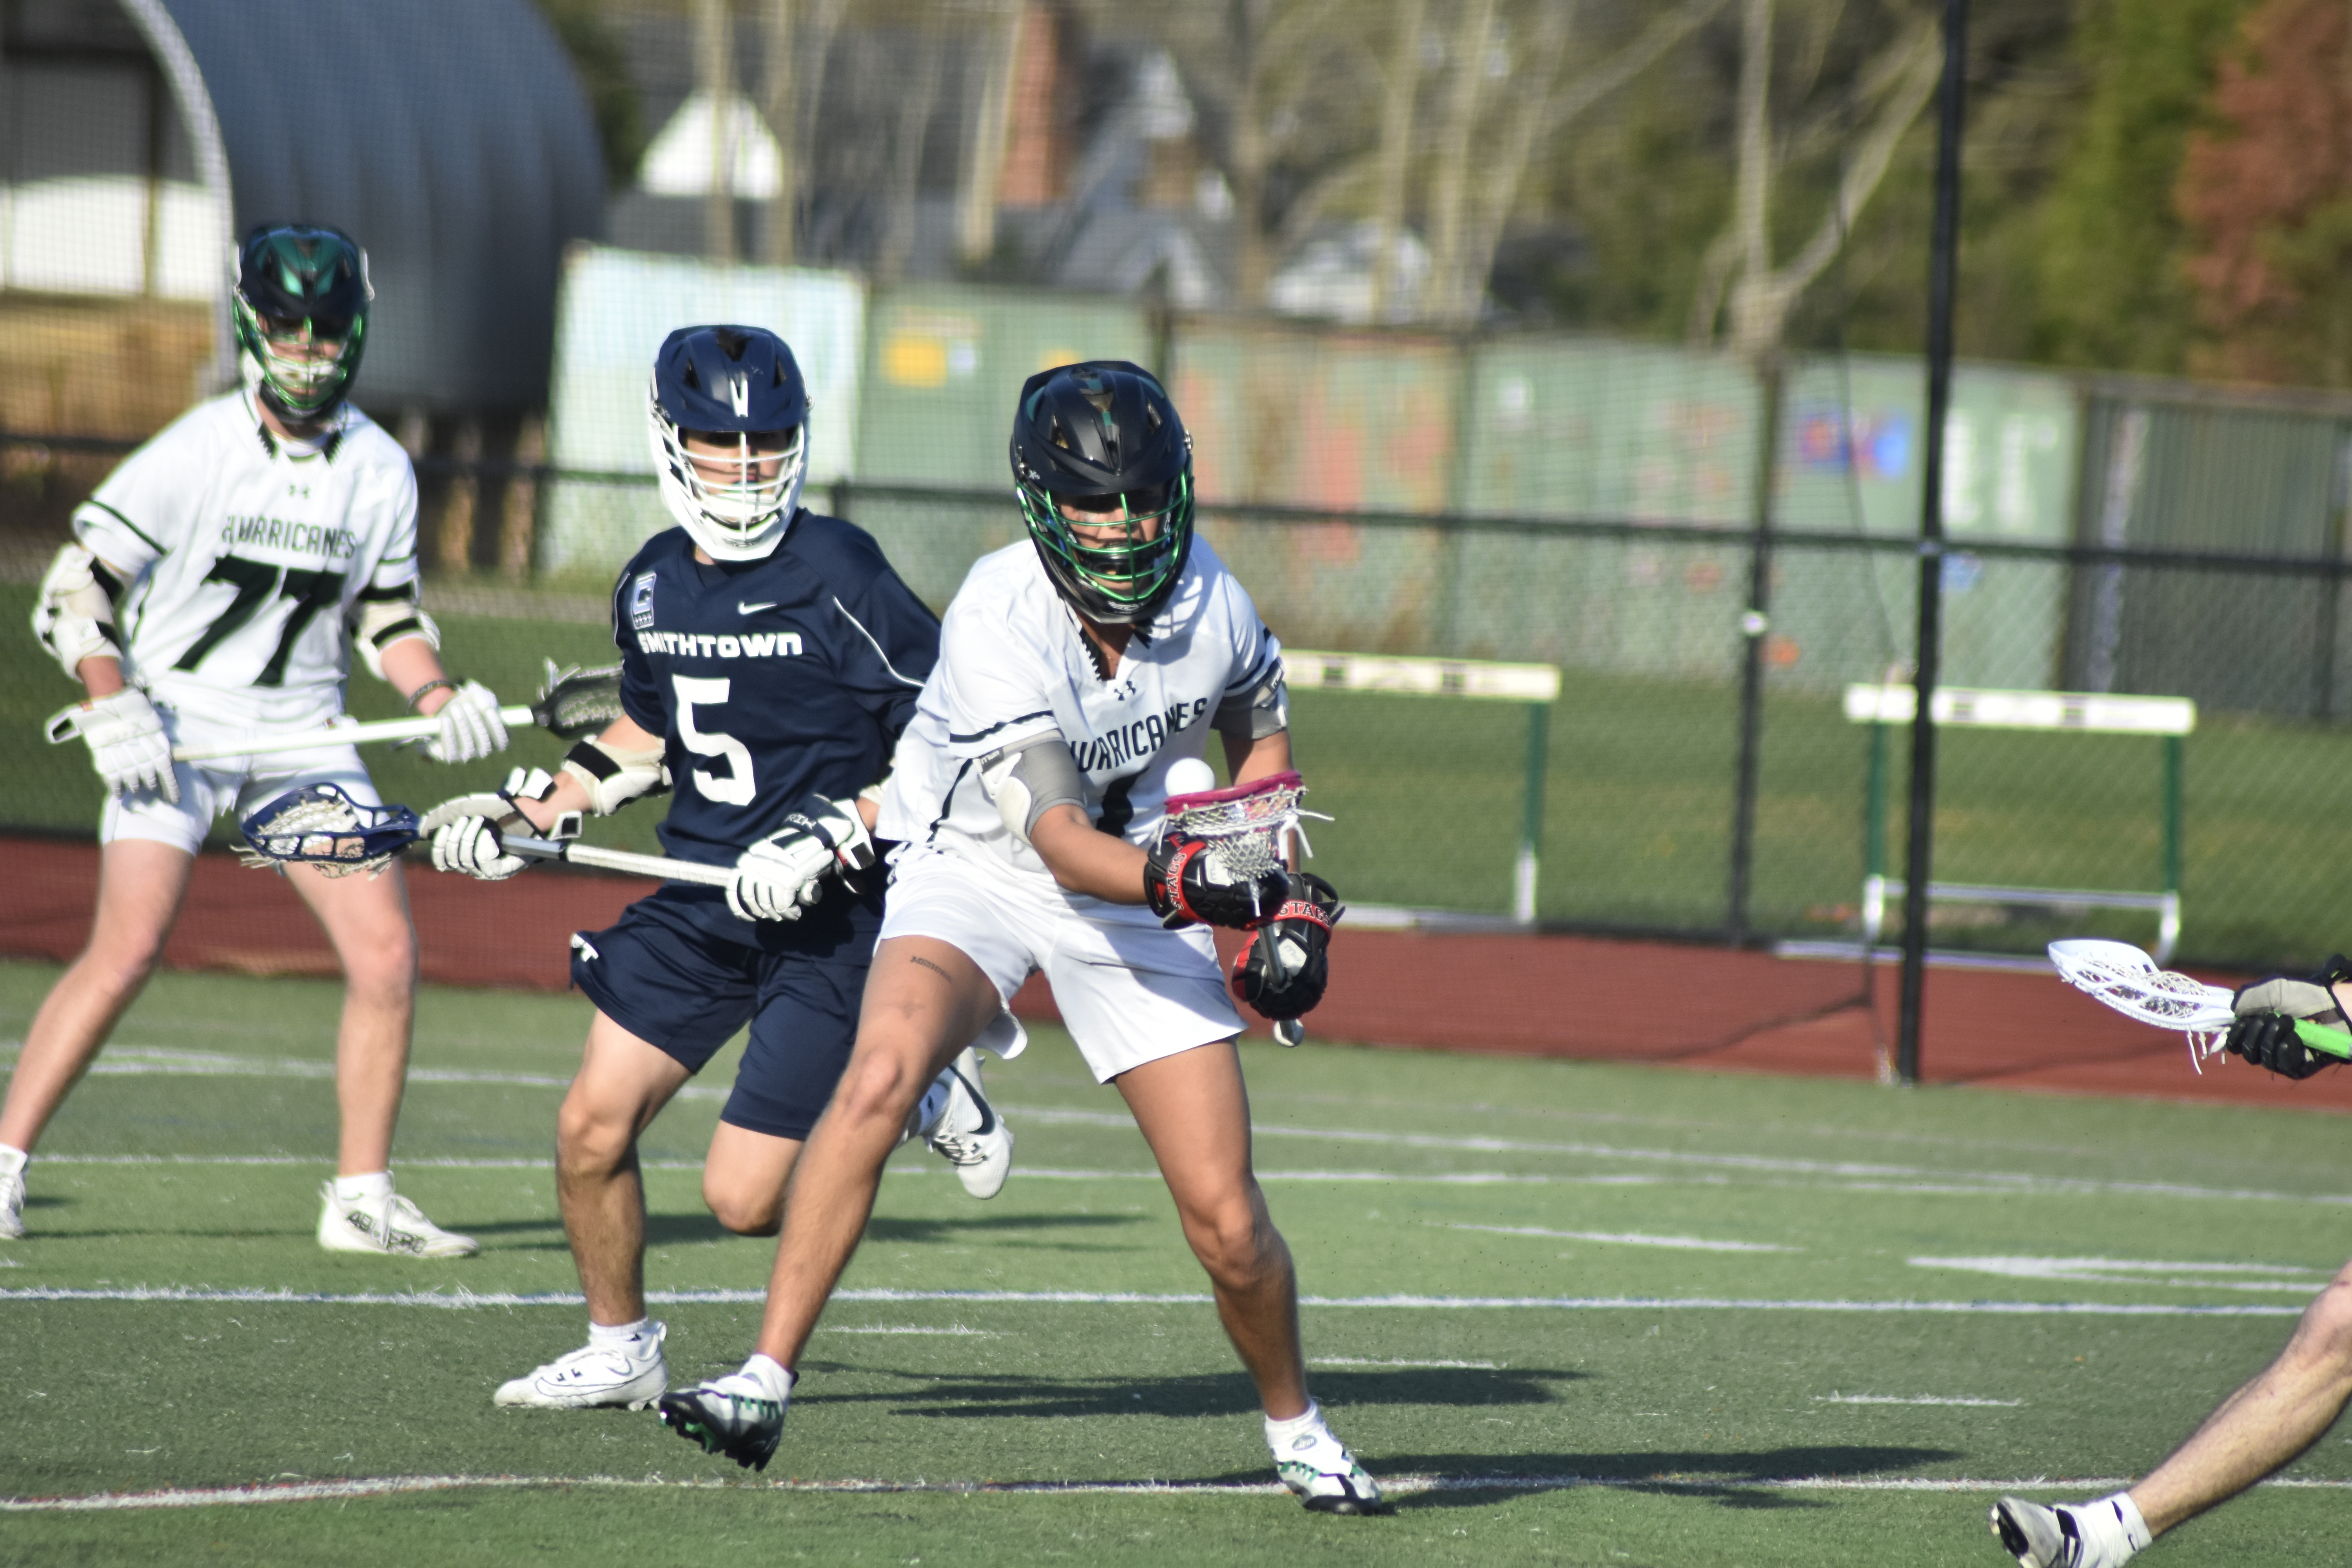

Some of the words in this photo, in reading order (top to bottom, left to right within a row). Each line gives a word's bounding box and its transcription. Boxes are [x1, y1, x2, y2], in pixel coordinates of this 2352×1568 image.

[221, 515, 356, 559] HURRICANES
[633, 577, 655, 615] C
[169, 554, 348, 688] 77
[637, 632, 802, 658] SMITHTOWN
[671, 673, 756, 806] 5
[785, 814, 817, 830] RIK
[1167, 852, 1187, 911] STAGS
[1278, 901, 1331, 927] STAGS
